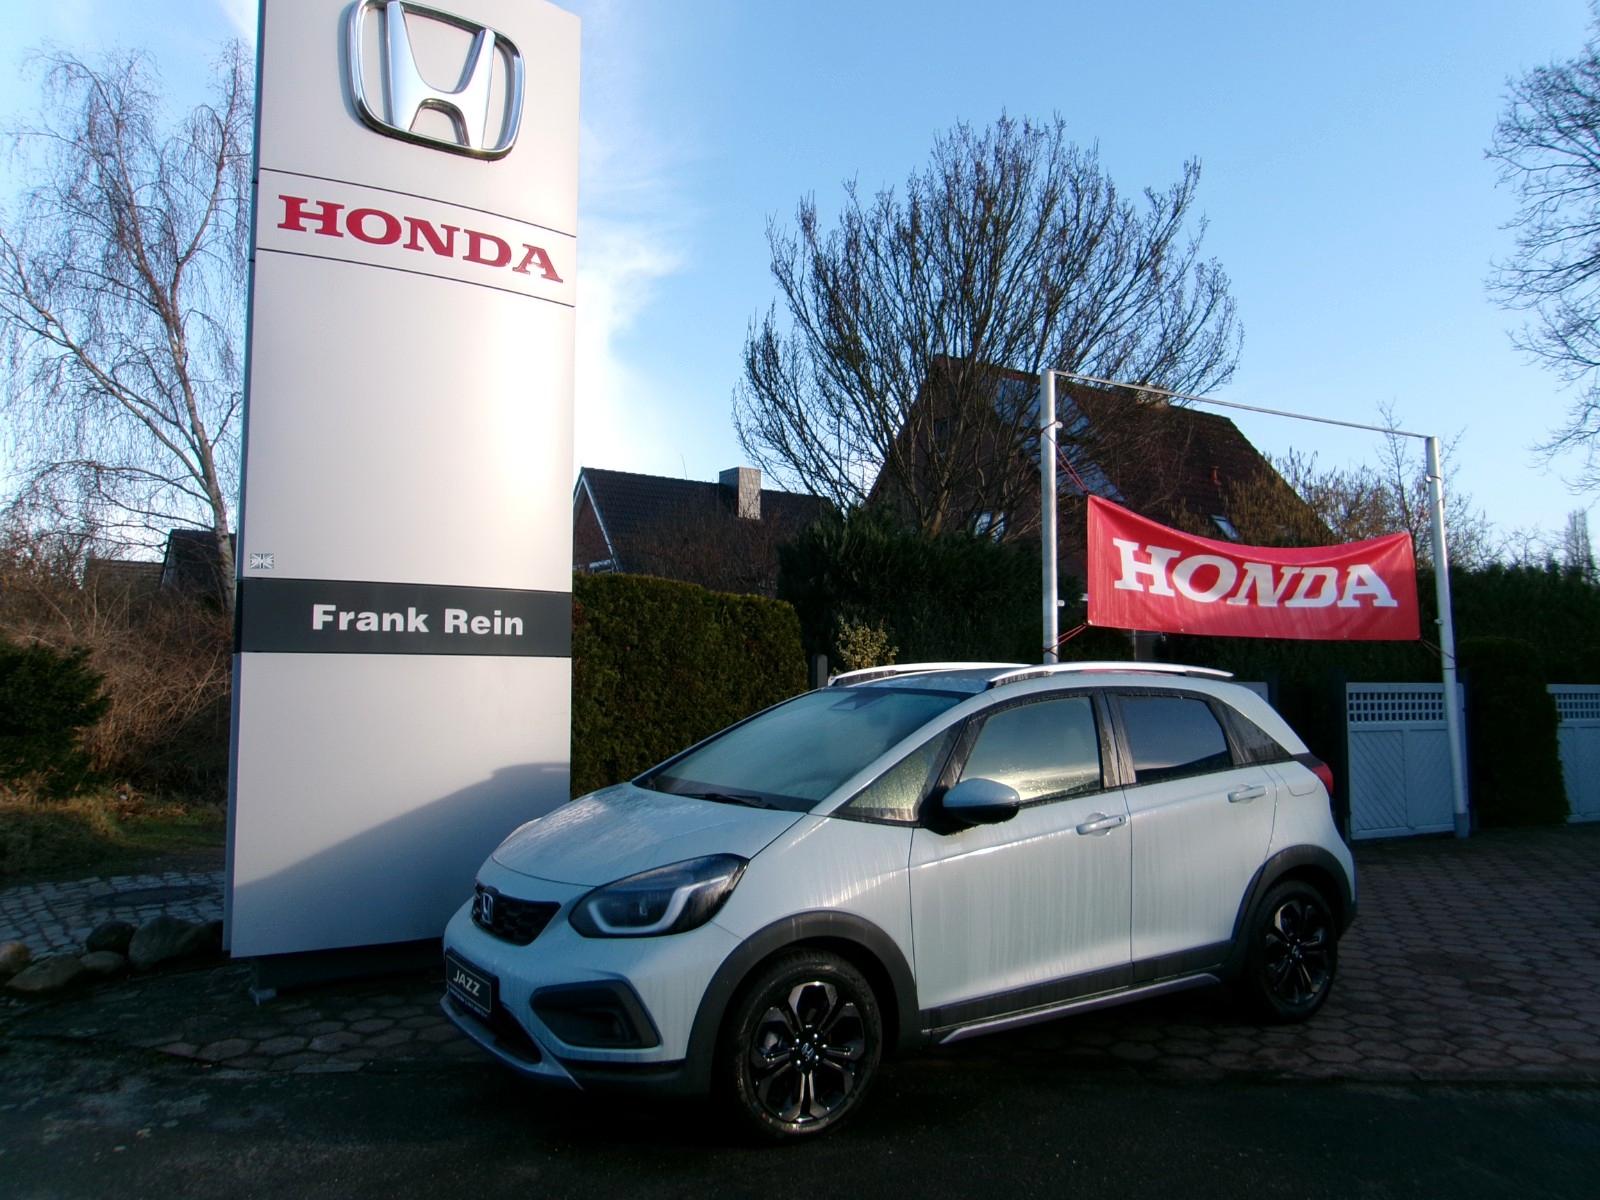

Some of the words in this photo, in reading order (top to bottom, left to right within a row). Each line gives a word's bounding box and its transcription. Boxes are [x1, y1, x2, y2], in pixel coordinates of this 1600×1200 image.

[277, 194, 563, 283] HONDA
[1112, 537, 1398, 608] HONDA
[312, 603, 430, 633] Frank
[444, 608, 524, 636] Rein
[453, 969, 481, 997] JAZZ
